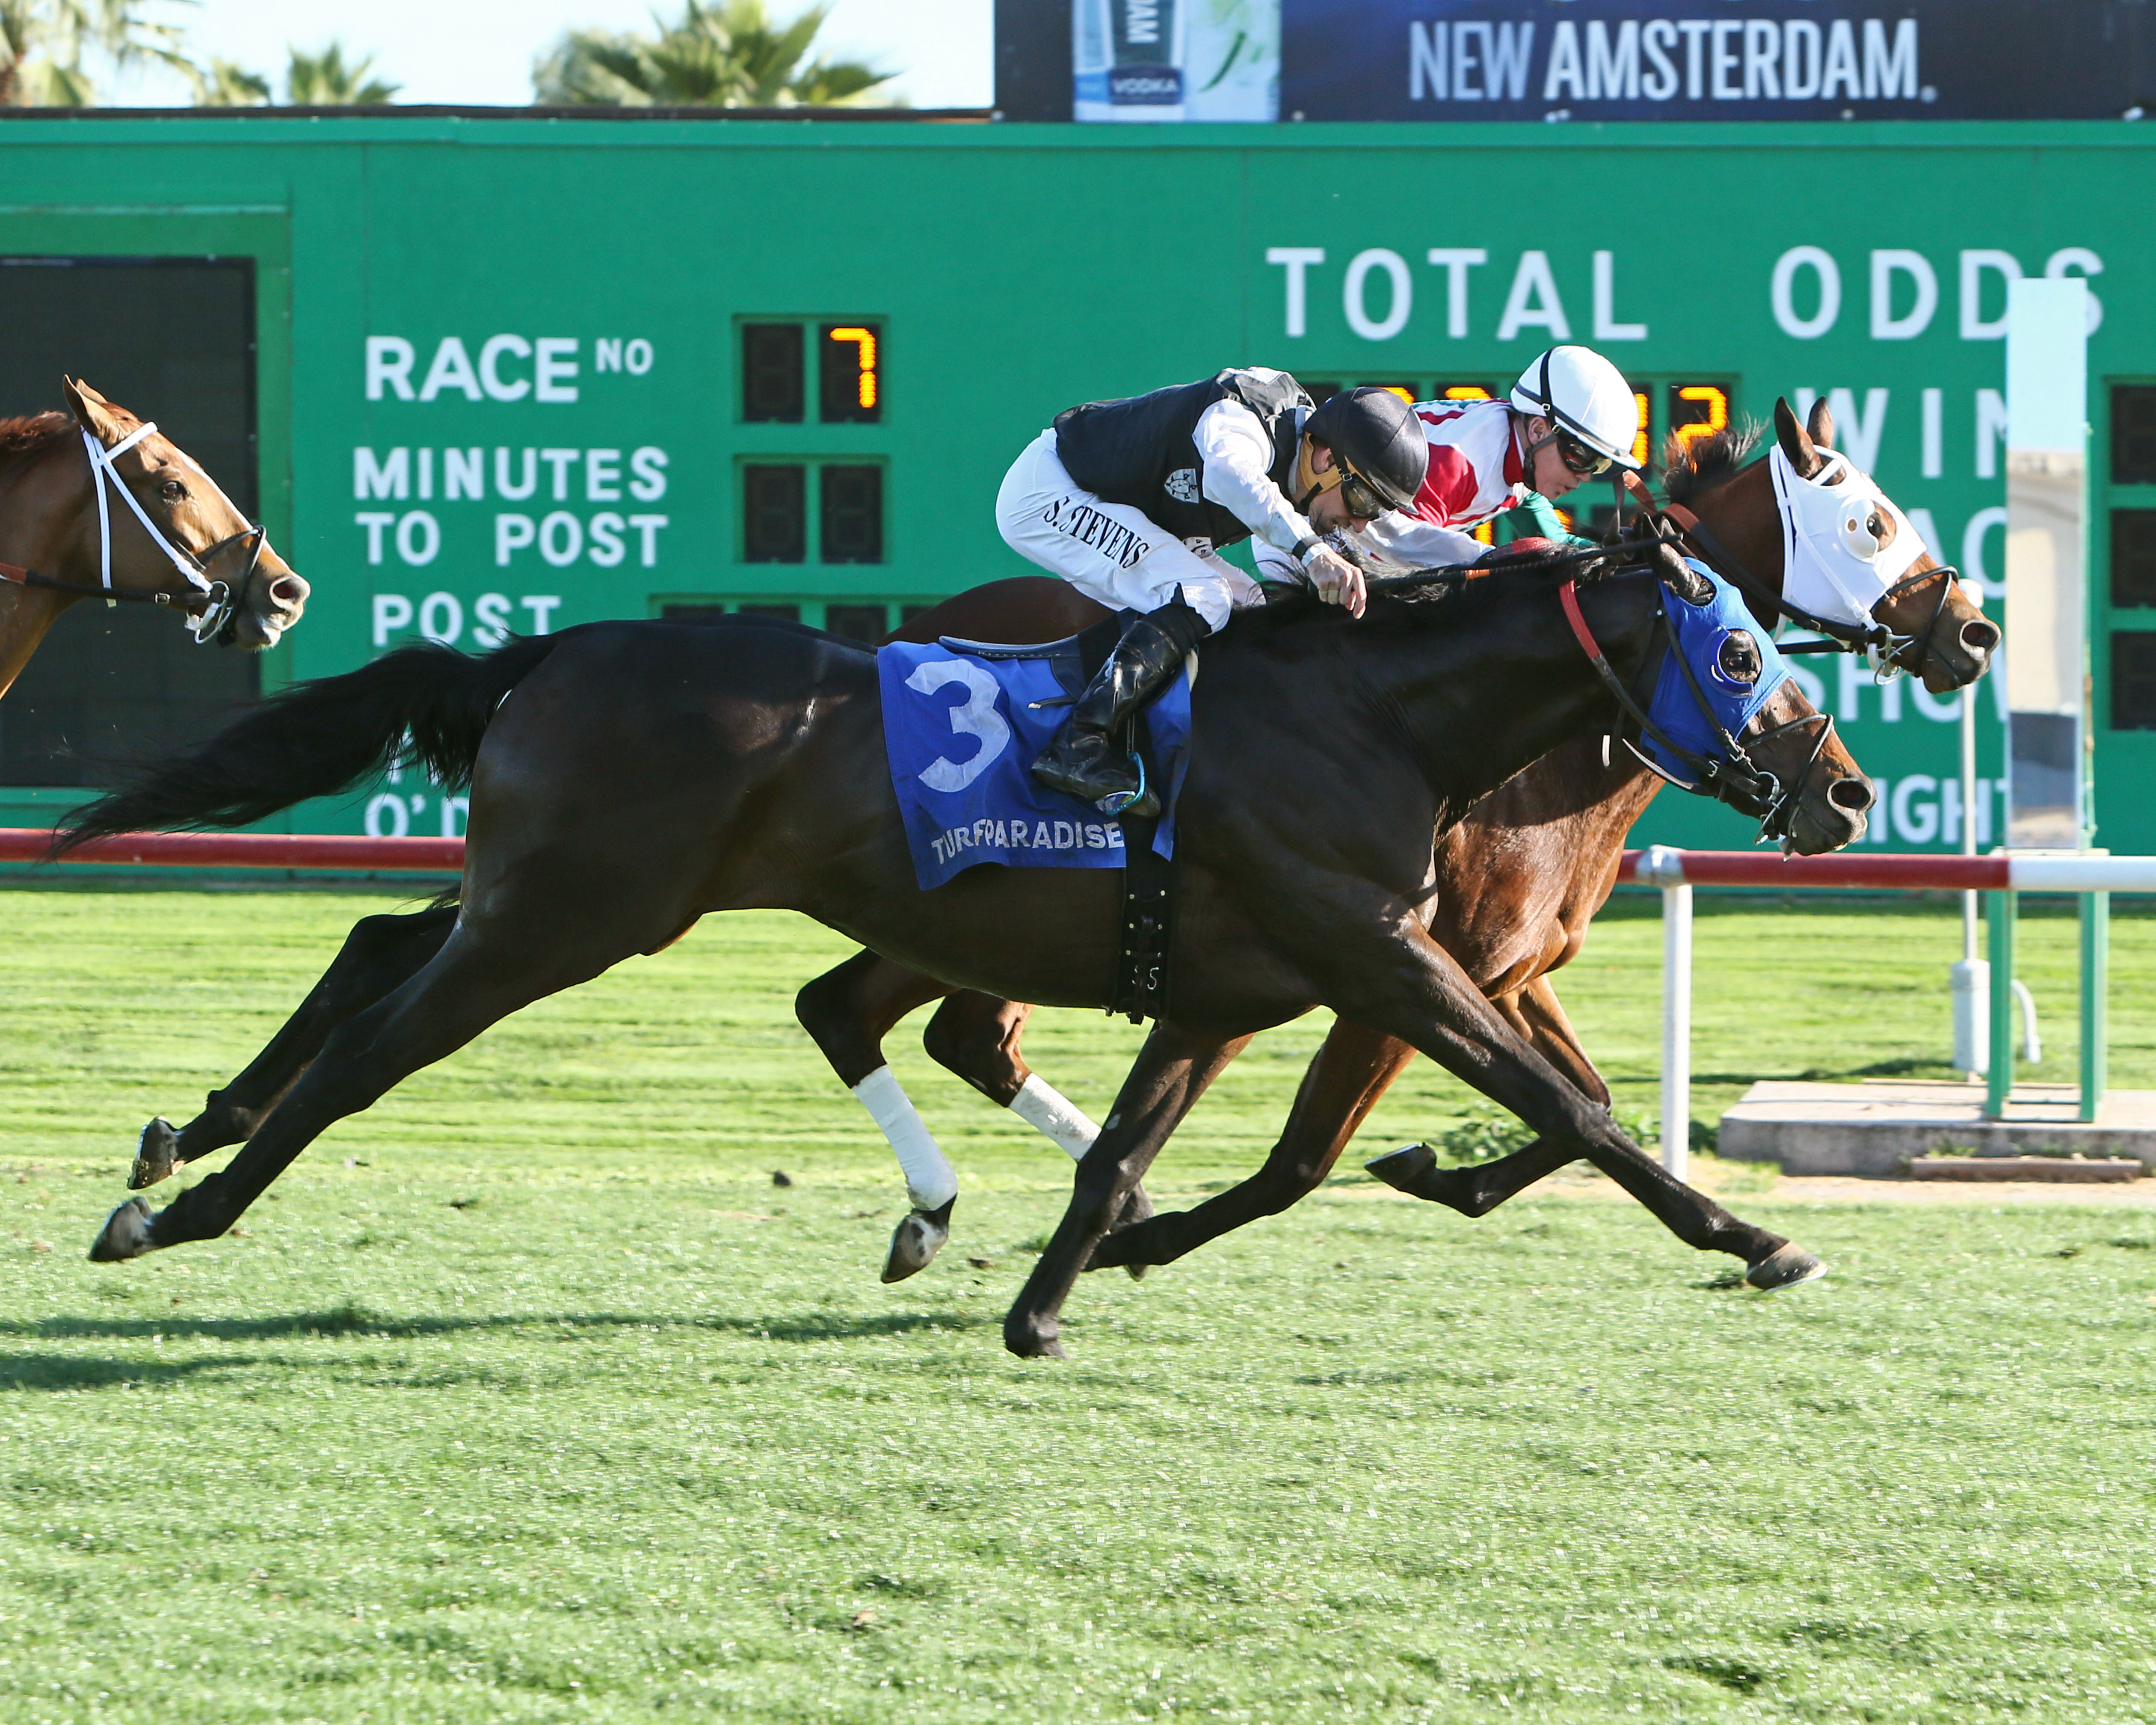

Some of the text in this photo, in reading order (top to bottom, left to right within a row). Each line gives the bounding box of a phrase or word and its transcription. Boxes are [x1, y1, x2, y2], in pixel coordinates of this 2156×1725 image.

[1112, 78, 1178, 93] VODKA
[1410, 19, 1937, 102] NEW AMSTERDAM.
[1266, 246, 2104, 341] TOTAL ODDS
[366, 334, 653, 402] RACE NO
[829, 328, 876, 408] 7
[354, 446, 669, 501] MINUTES
[355, 510, 669, 566] TO POST
[1043, 496, 1149, 568] S. STEVENS
[373, 591, 561, 649] POST
[904, 658, 1011, 793] 3
